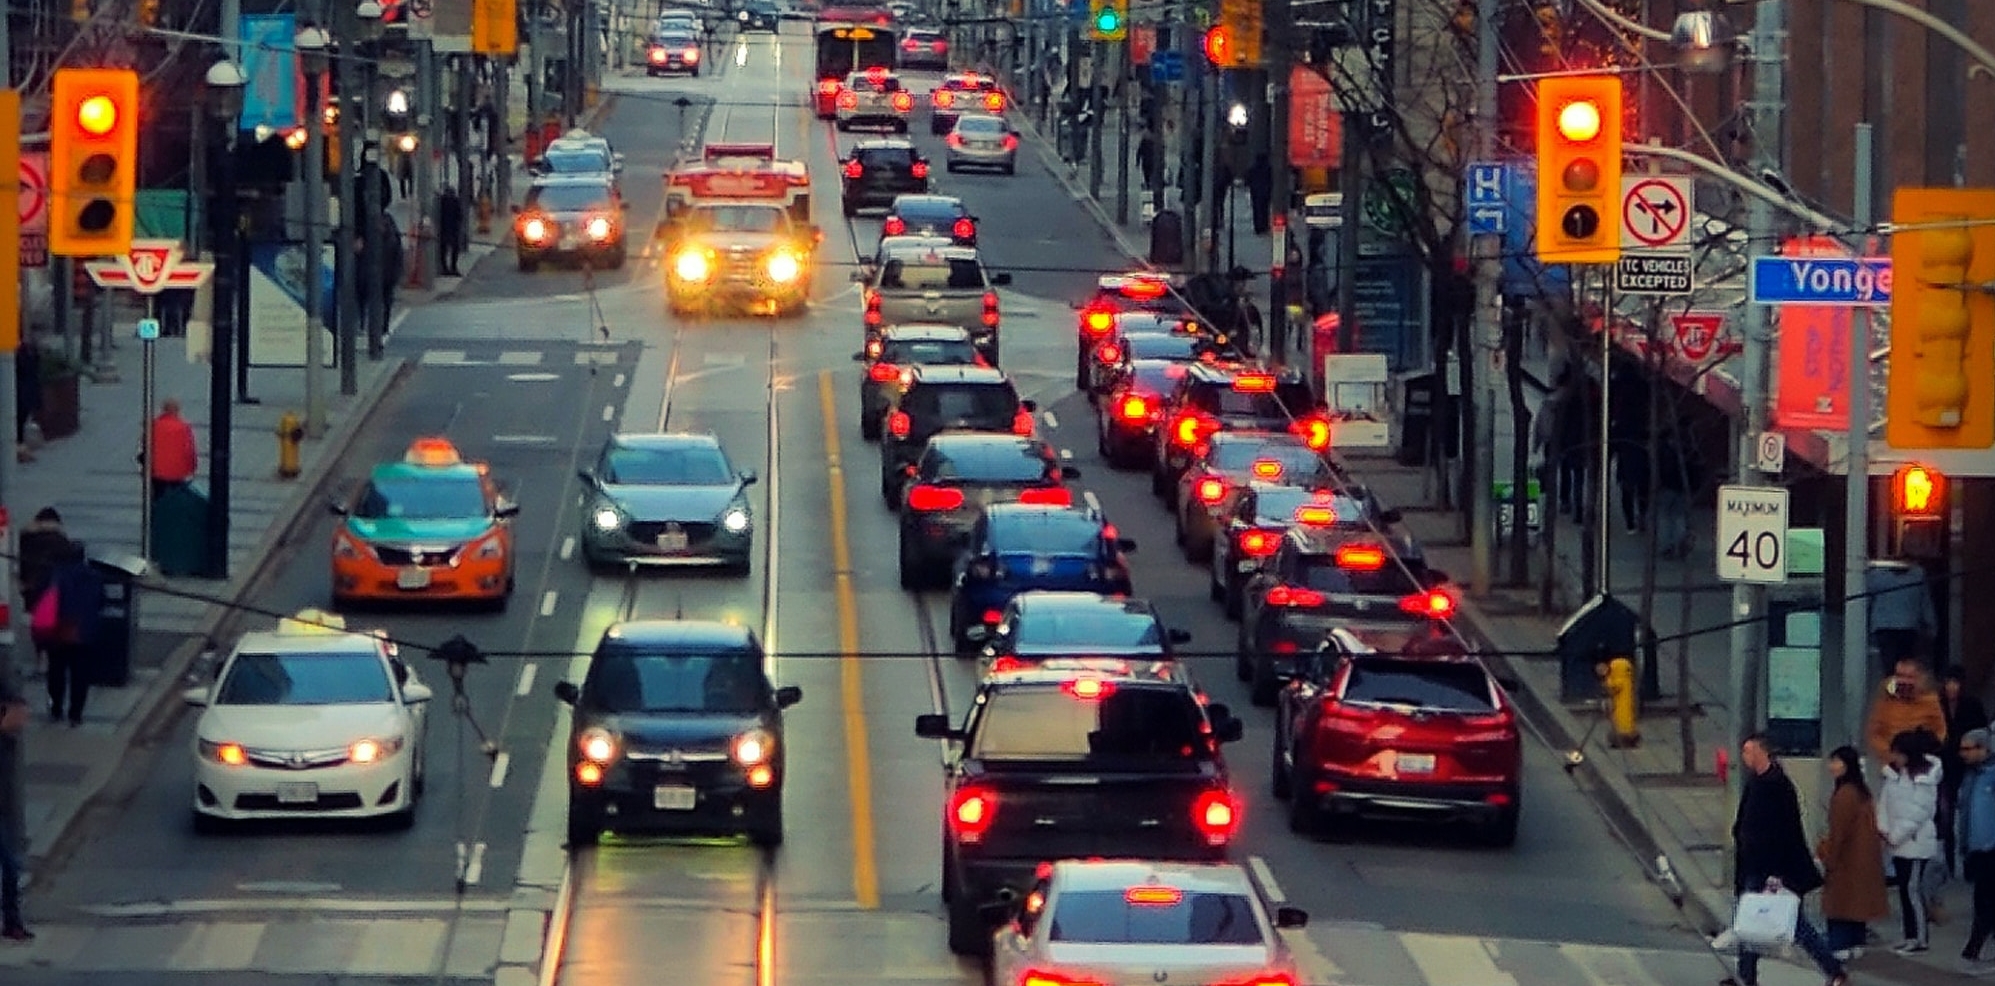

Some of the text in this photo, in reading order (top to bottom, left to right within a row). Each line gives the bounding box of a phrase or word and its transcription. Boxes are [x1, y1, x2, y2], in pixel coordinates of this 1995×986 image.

[1642, 259, 1690, 273] VEHICLES
[1621, 274, 1687, 288] EXCEPTED
[1790, 261, 1892, 300] Yonge
[1727, 500, 1779, 515] MAXIMUM
[1726, 530, 1779, 569] 40
